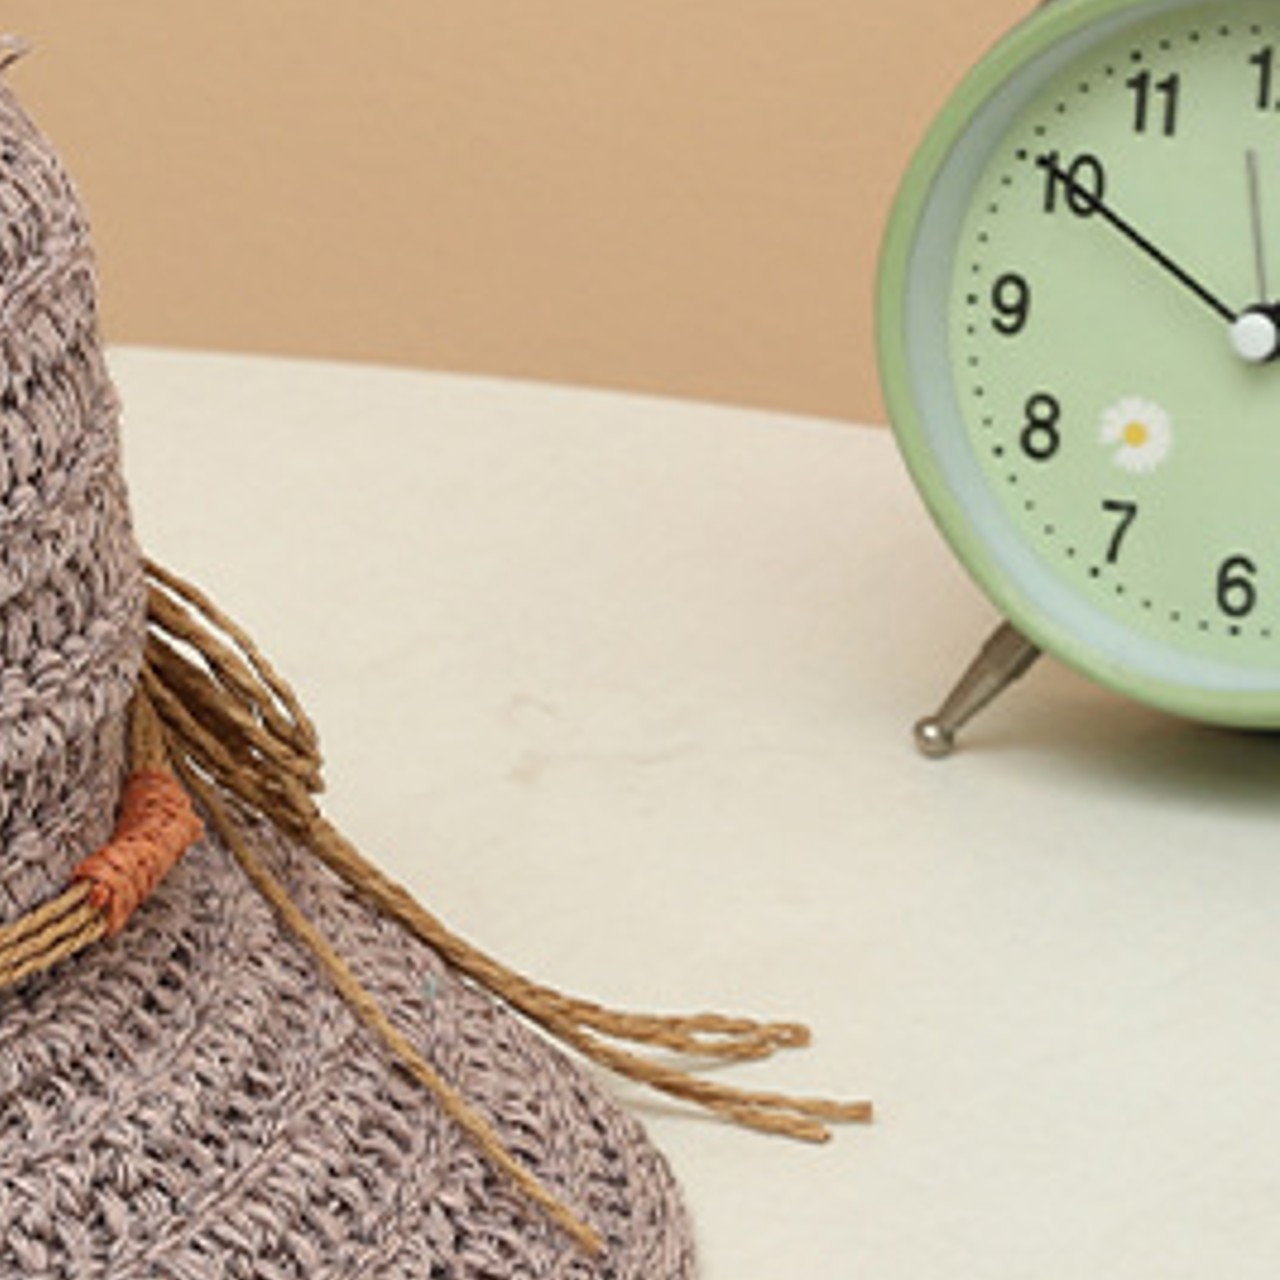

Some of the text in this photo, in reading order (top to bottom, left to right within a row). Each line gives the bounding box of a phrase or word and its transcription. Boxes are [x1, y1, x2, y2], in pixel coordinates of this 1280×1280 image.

[1125, 69, 1181, 136] 11
[1248, 45, 1280, 113] 1
[1038, 150, 1106, 219] 10
[990, 273, 1030, 335] 9
[1019, 392, 1061, 461] 8
[1100, 499, 1138, 563] 7
[1215, 555, 1257, 617] 6
